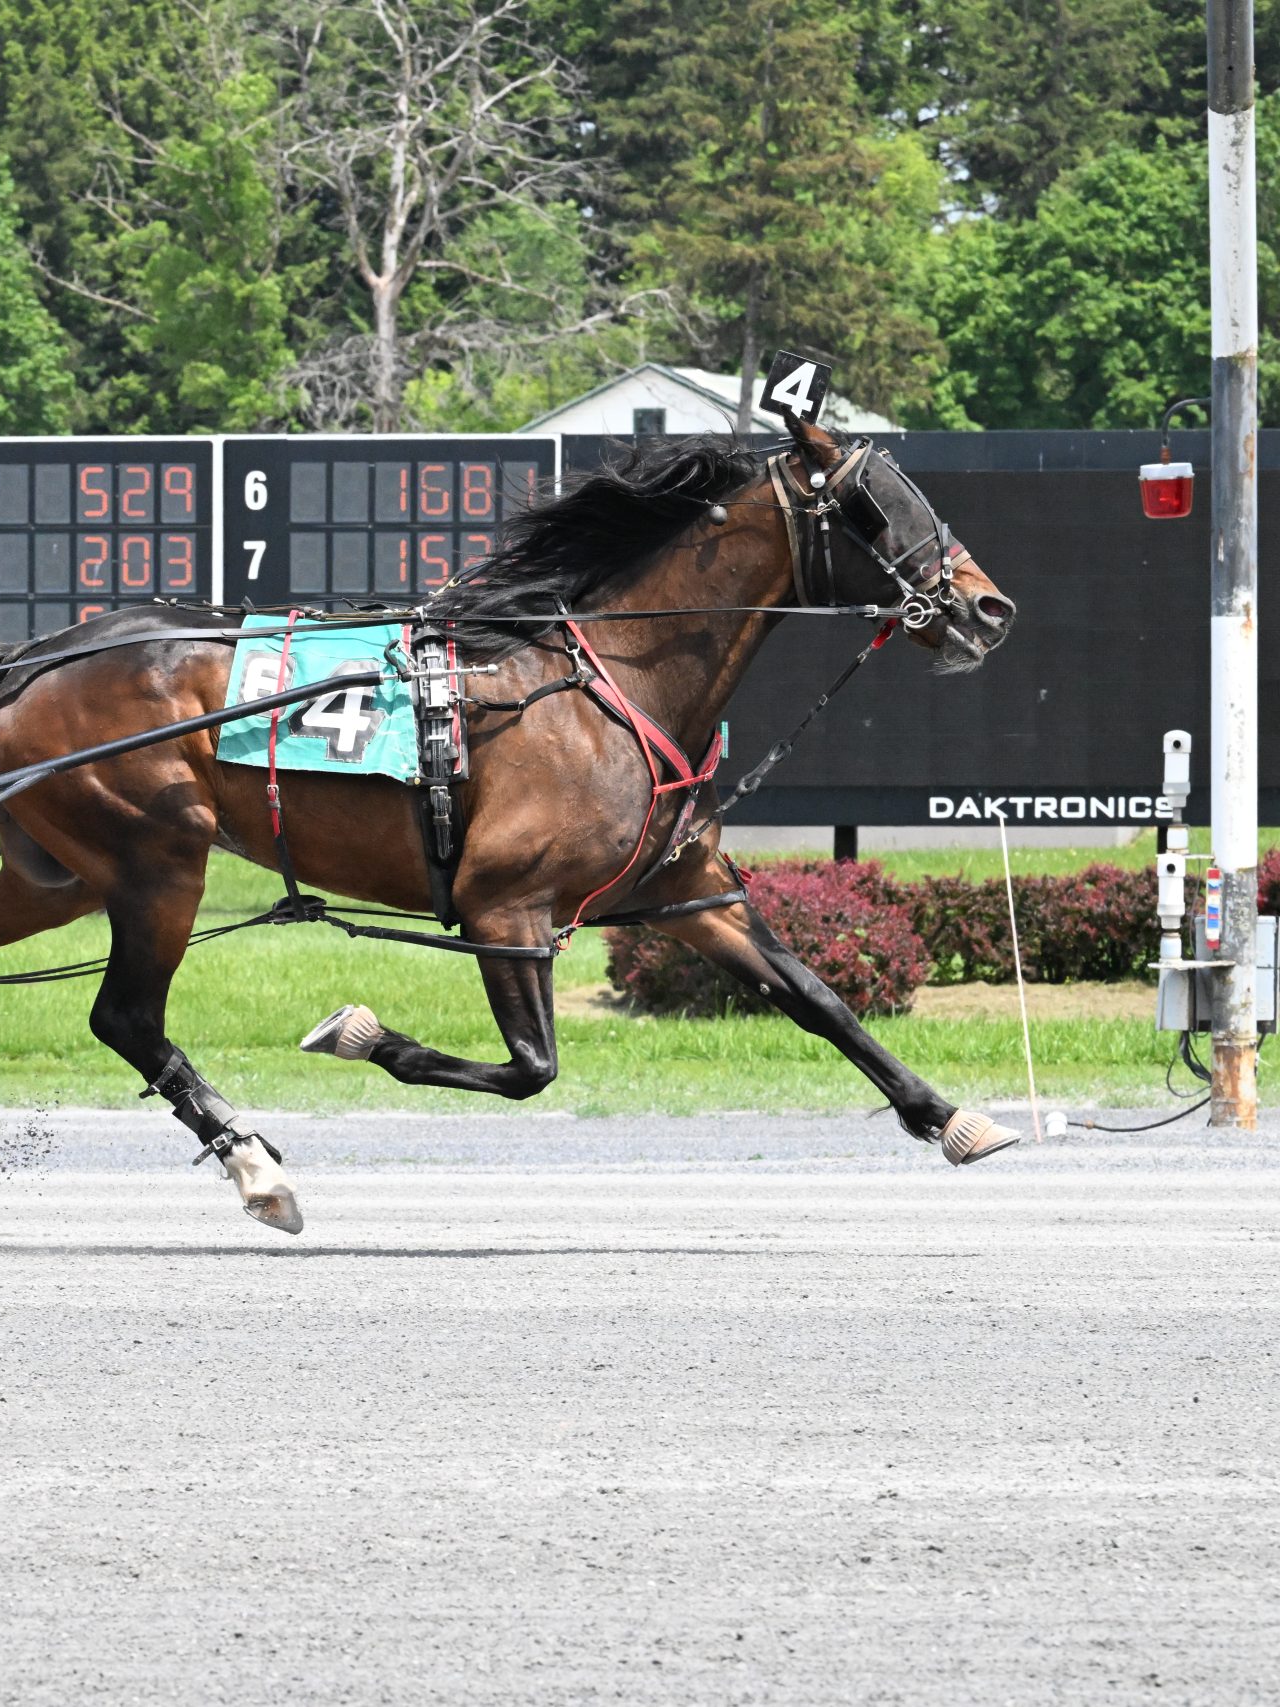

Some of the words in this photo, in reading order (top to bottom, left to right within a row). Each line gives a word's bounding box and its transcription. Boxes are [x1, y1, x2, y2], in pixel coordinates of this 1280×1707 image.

[770, 361, 817, 419] 4
[80, 466, 193, 518] 529
[243, 470, 268, 511] 6
[80, 535, 192, 587] 203
[242, 540, 267, 580] 7
[301, 668, 372, 753] 4
[928, 795, 1175, 819] DAKTRONICS
